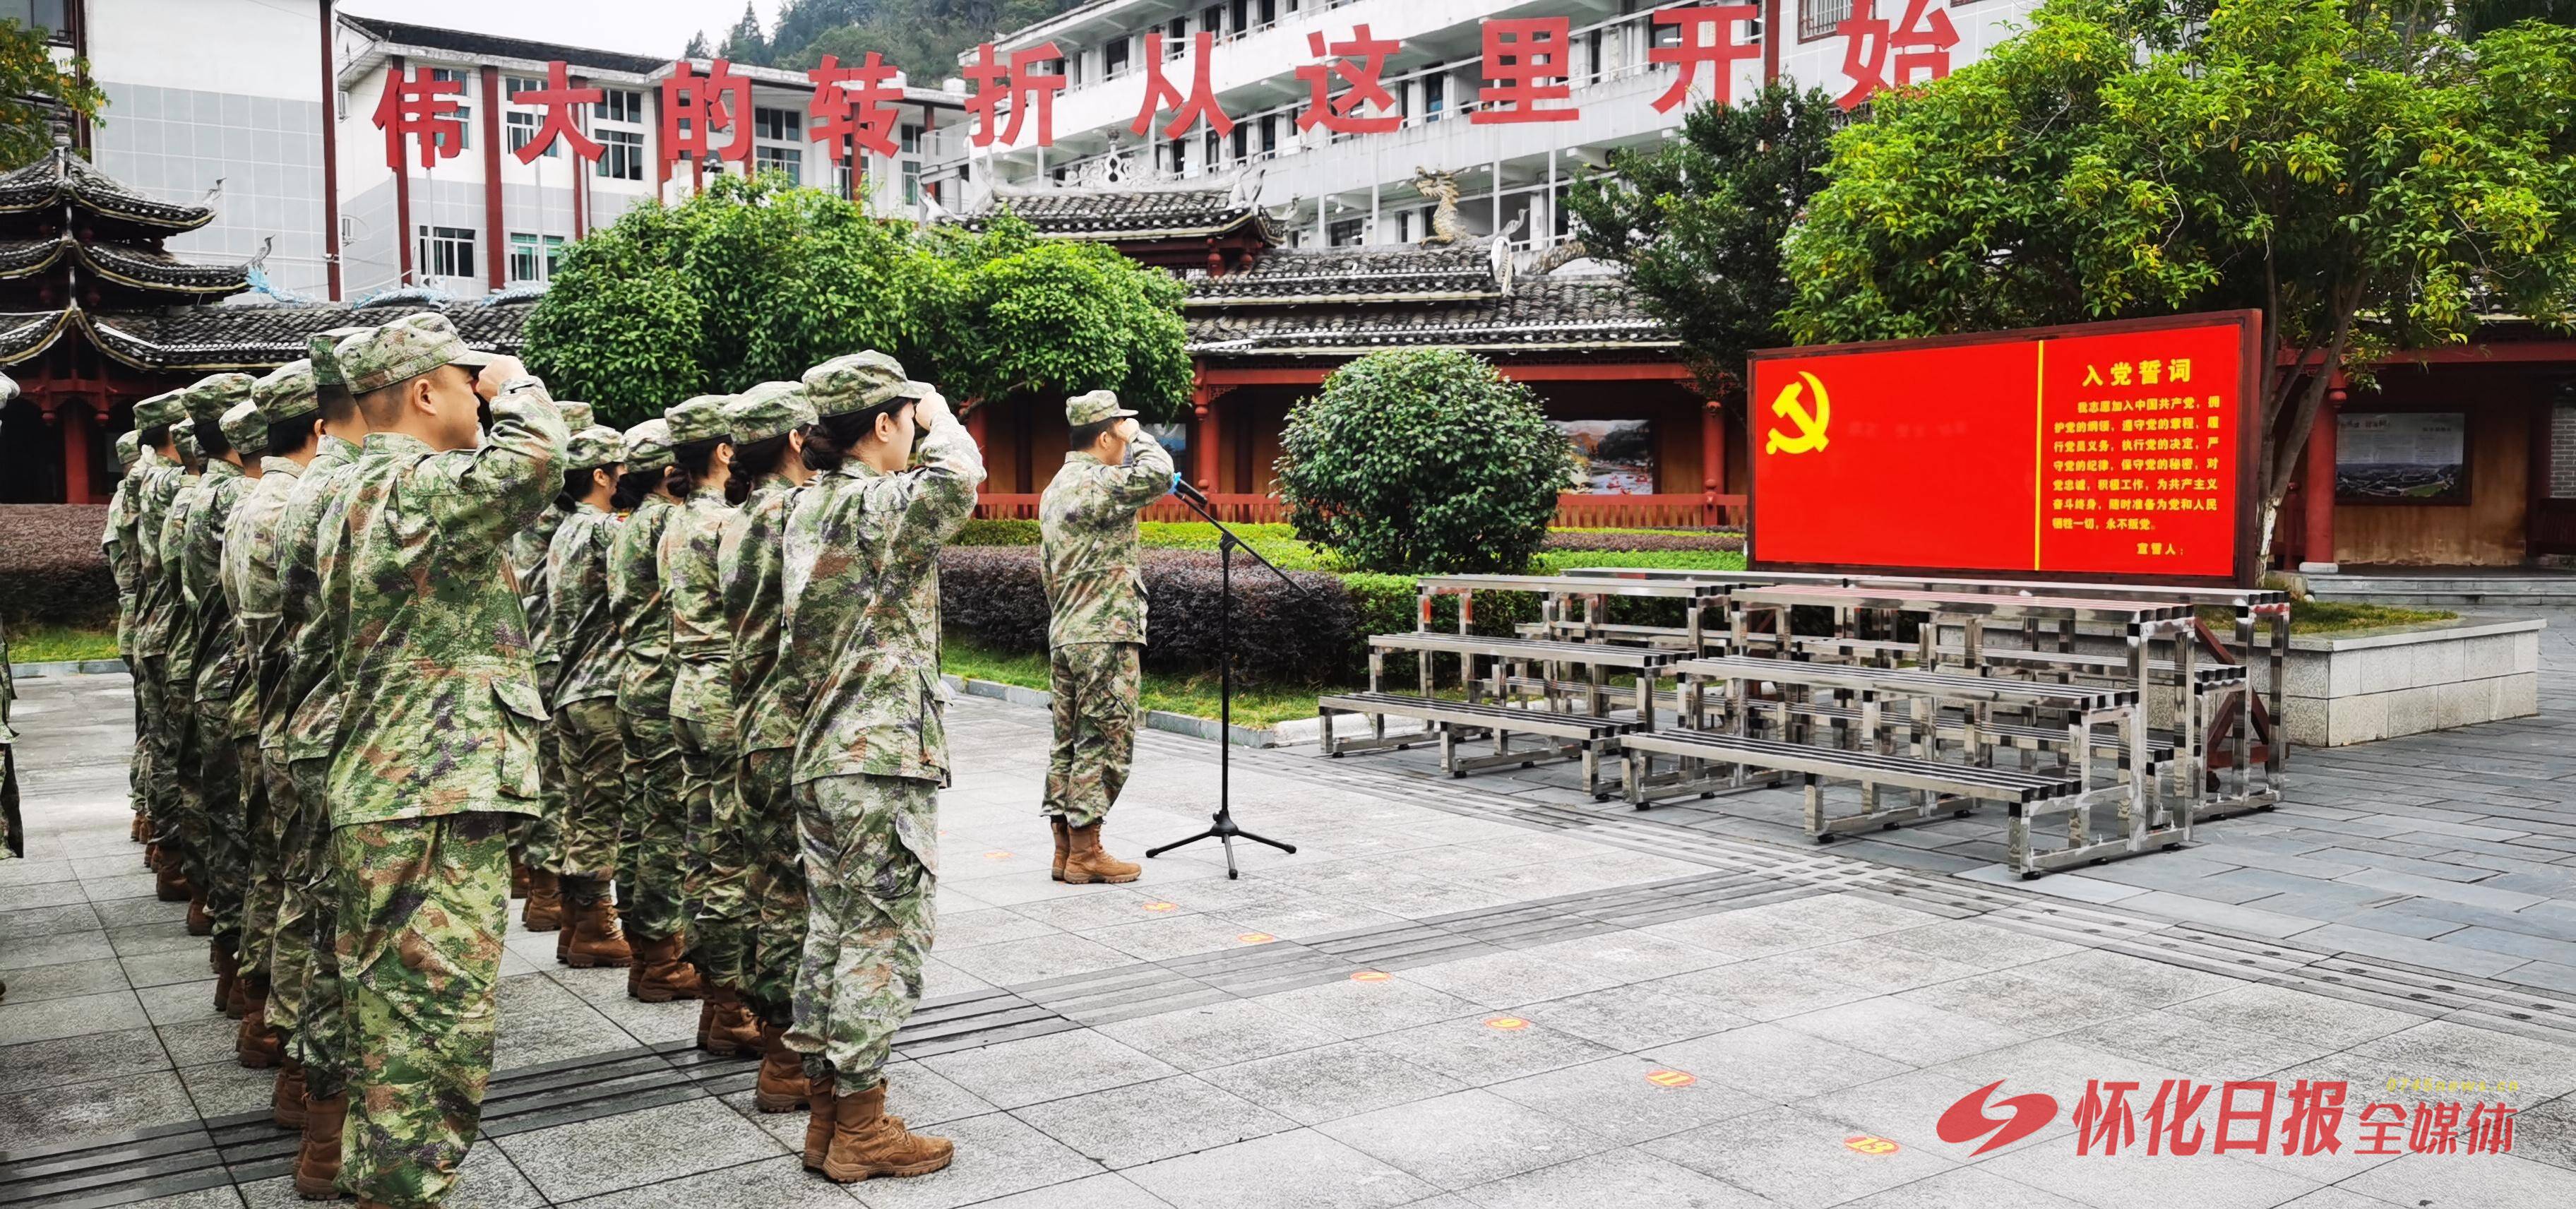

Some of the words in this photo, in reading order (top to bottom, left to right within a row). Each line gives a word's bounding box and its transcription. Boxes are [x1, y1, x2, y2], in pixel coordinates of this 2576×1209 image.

[372, 0, 1960, 169] 伟大的转折从这里开始
[2082, 358, 2191, 386] 入党誓词
[1646, 1071, 1692, 1085] 11
[1844, 1136, 1896, 1154] 13
